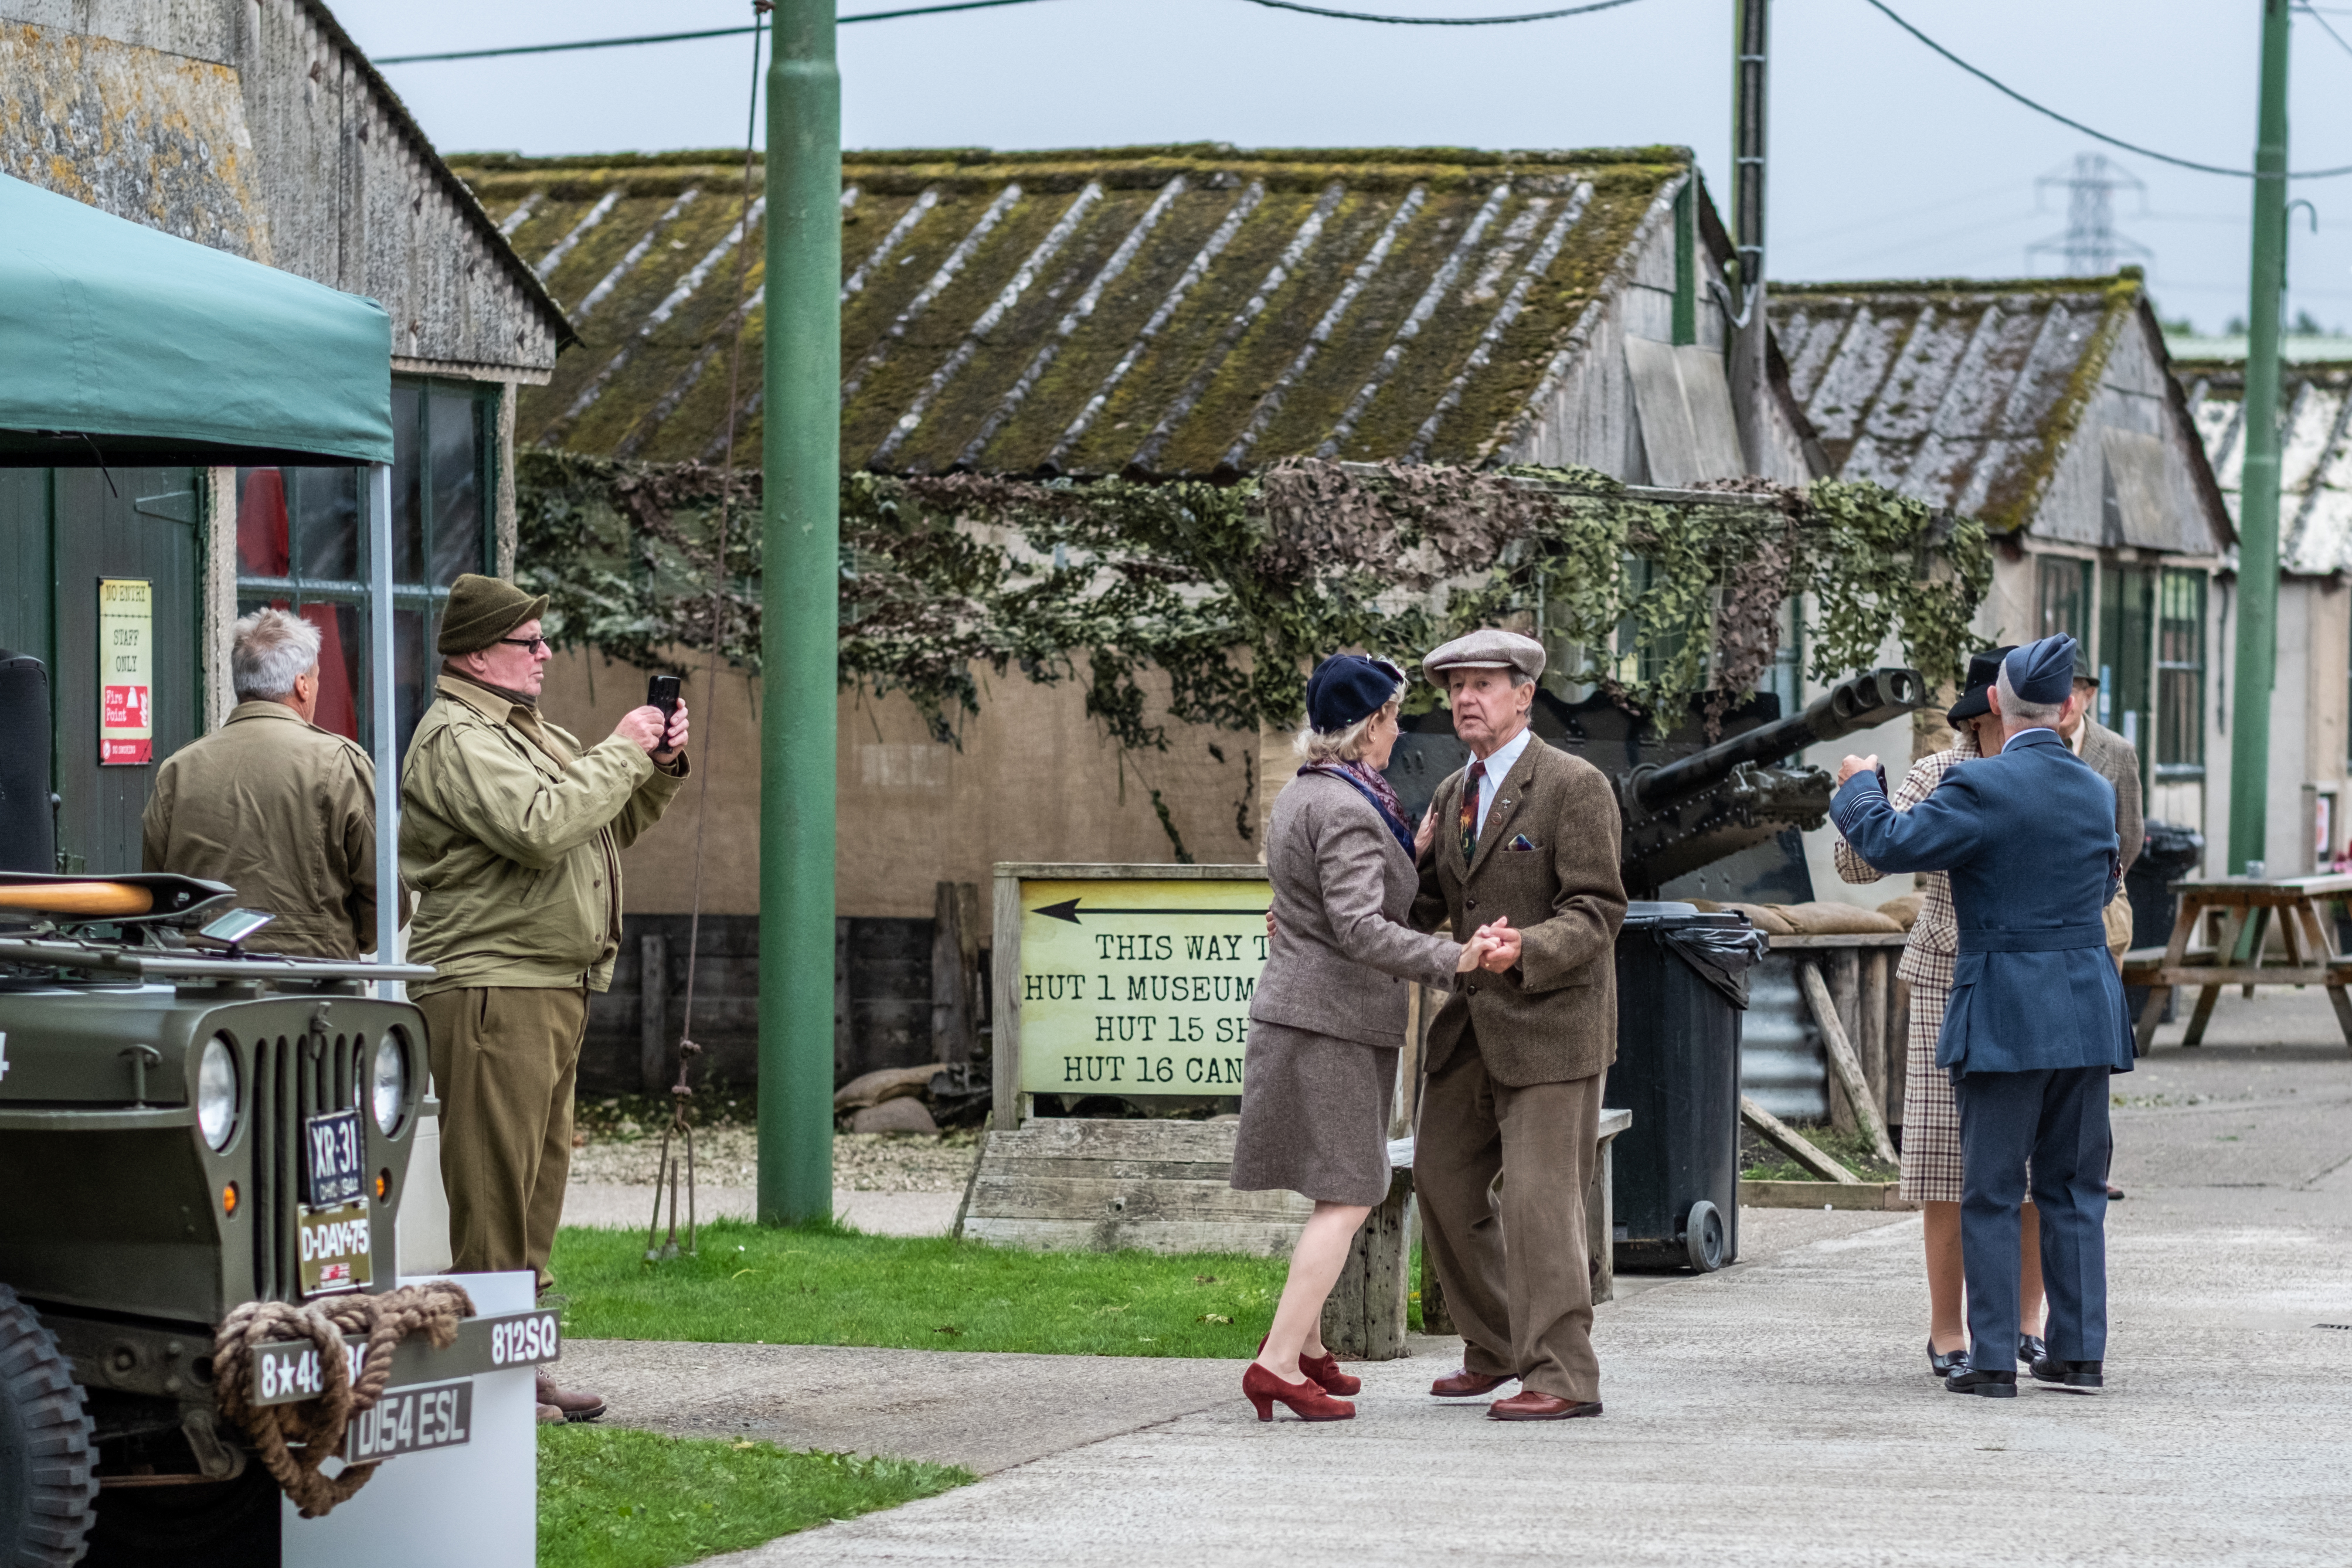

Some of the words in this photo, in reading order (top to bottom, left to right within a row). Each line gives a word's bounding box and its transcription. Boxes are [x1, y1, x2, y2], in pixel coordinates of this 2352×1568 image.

[106, 585, 117, 601] NO
[120, 585, 146, 602] ENTRY
[114, 629, 139, 646] STAFF
[115, 656, 138, 672] ONLY
[106, 689, 123, 704] Fire
[106, 707, 127, 722] Point
[1096, 934, 1172, 960] THIS
[1185, 935, 1243, 961] WAY
[1253, 936, 1268, 961] T
[1025, 975, 1085, 1000] HUT
[1097, 975, 1116, 1000] 1
[1127, 976, 1255, 1001] MUSEUM
[1096, 1016, 1156, 1042] HUT
[1168, 1017, 1204, 1042] 15
[1216, 1018, 1249, 1043] SH
[1063, 1057, 1124, 1081] HUT
[1137, 1057, 1173, 1082] 16
[1186, 1058, 1243, 1083] CAN
[301, 1219, 369, 1261] D-DAY+75
[492, 1315, 556, 1365] 812SQ
[358, 1396, 413, 1455] D154
[417, 1389, 465, 1445] ESL
